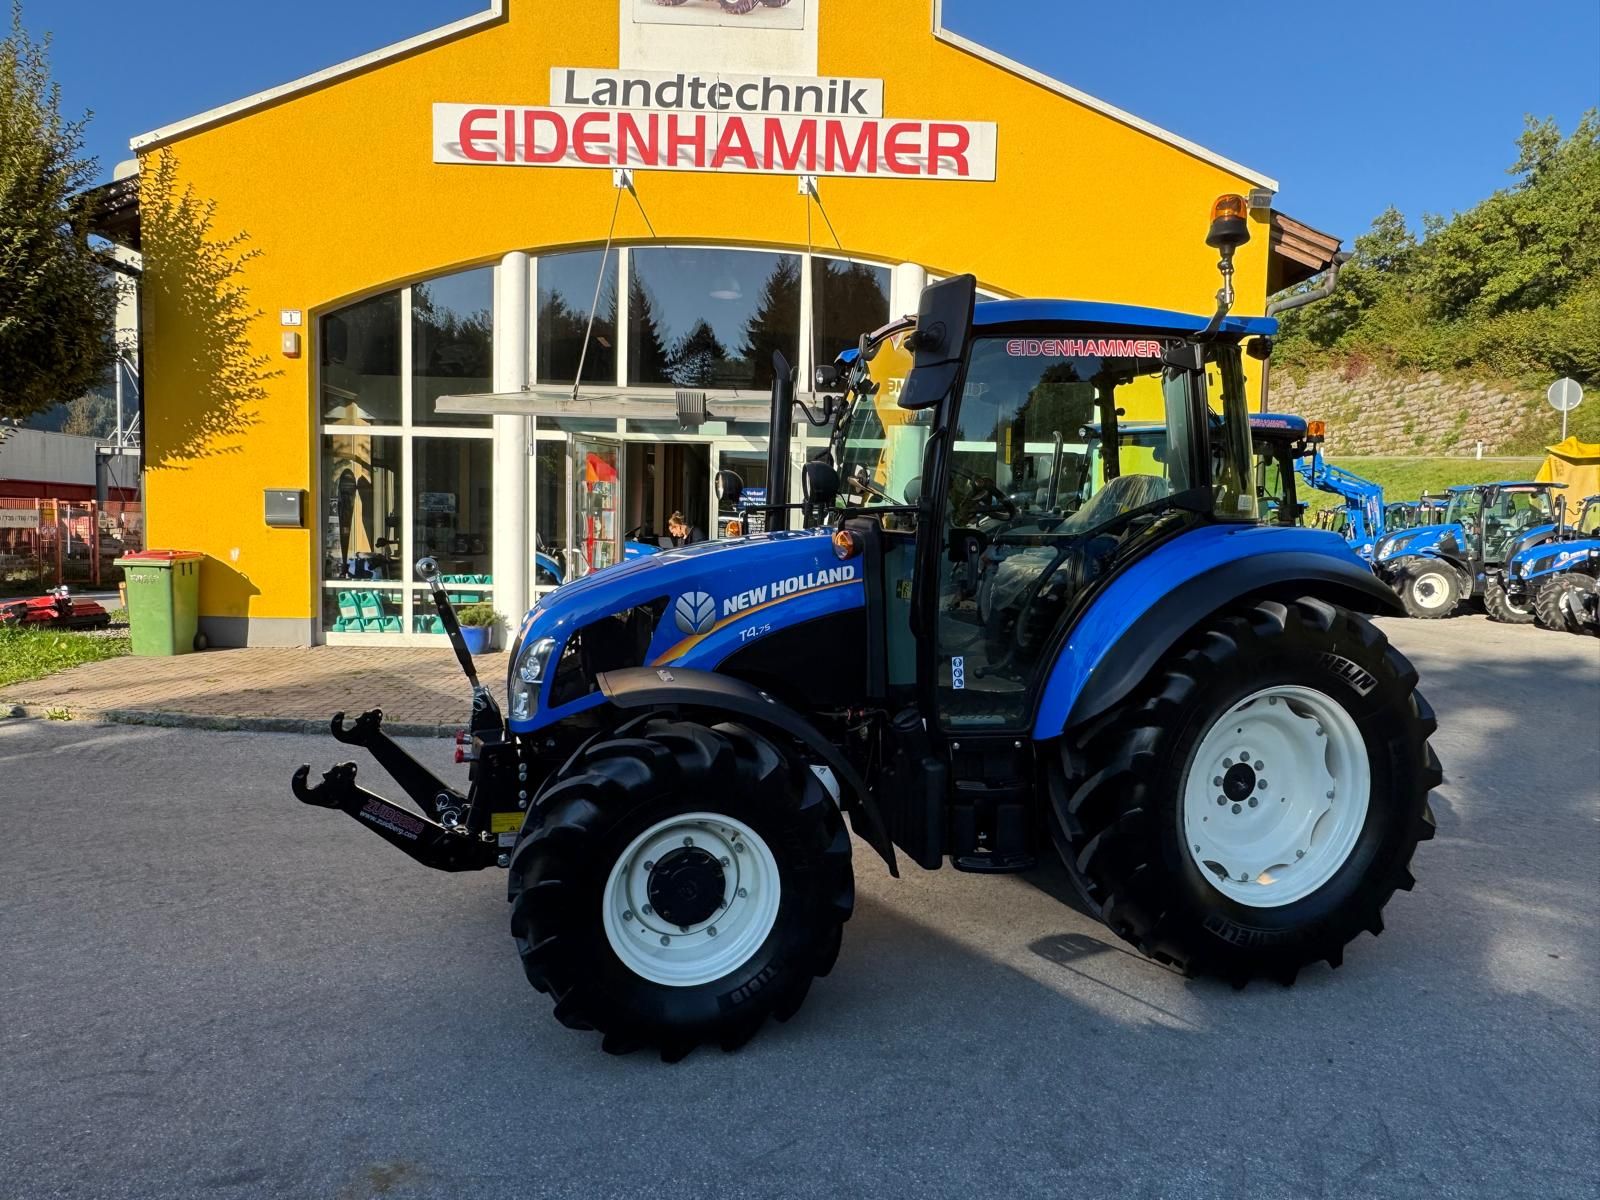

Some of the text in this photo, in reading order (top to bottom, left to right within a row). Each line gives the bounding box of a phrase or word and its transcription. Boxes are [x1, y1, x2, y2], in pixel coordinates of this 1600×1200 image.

[565, 69, 868, 114] Landtechnik
[459, 108, 970, 176] EIDENHAMMER
[1006, 339, 1162, 358] EIDENHAMMER
[723, 565, 855, 616] NEW HOLLAND
[739, 623, 771, 642] T4.75
